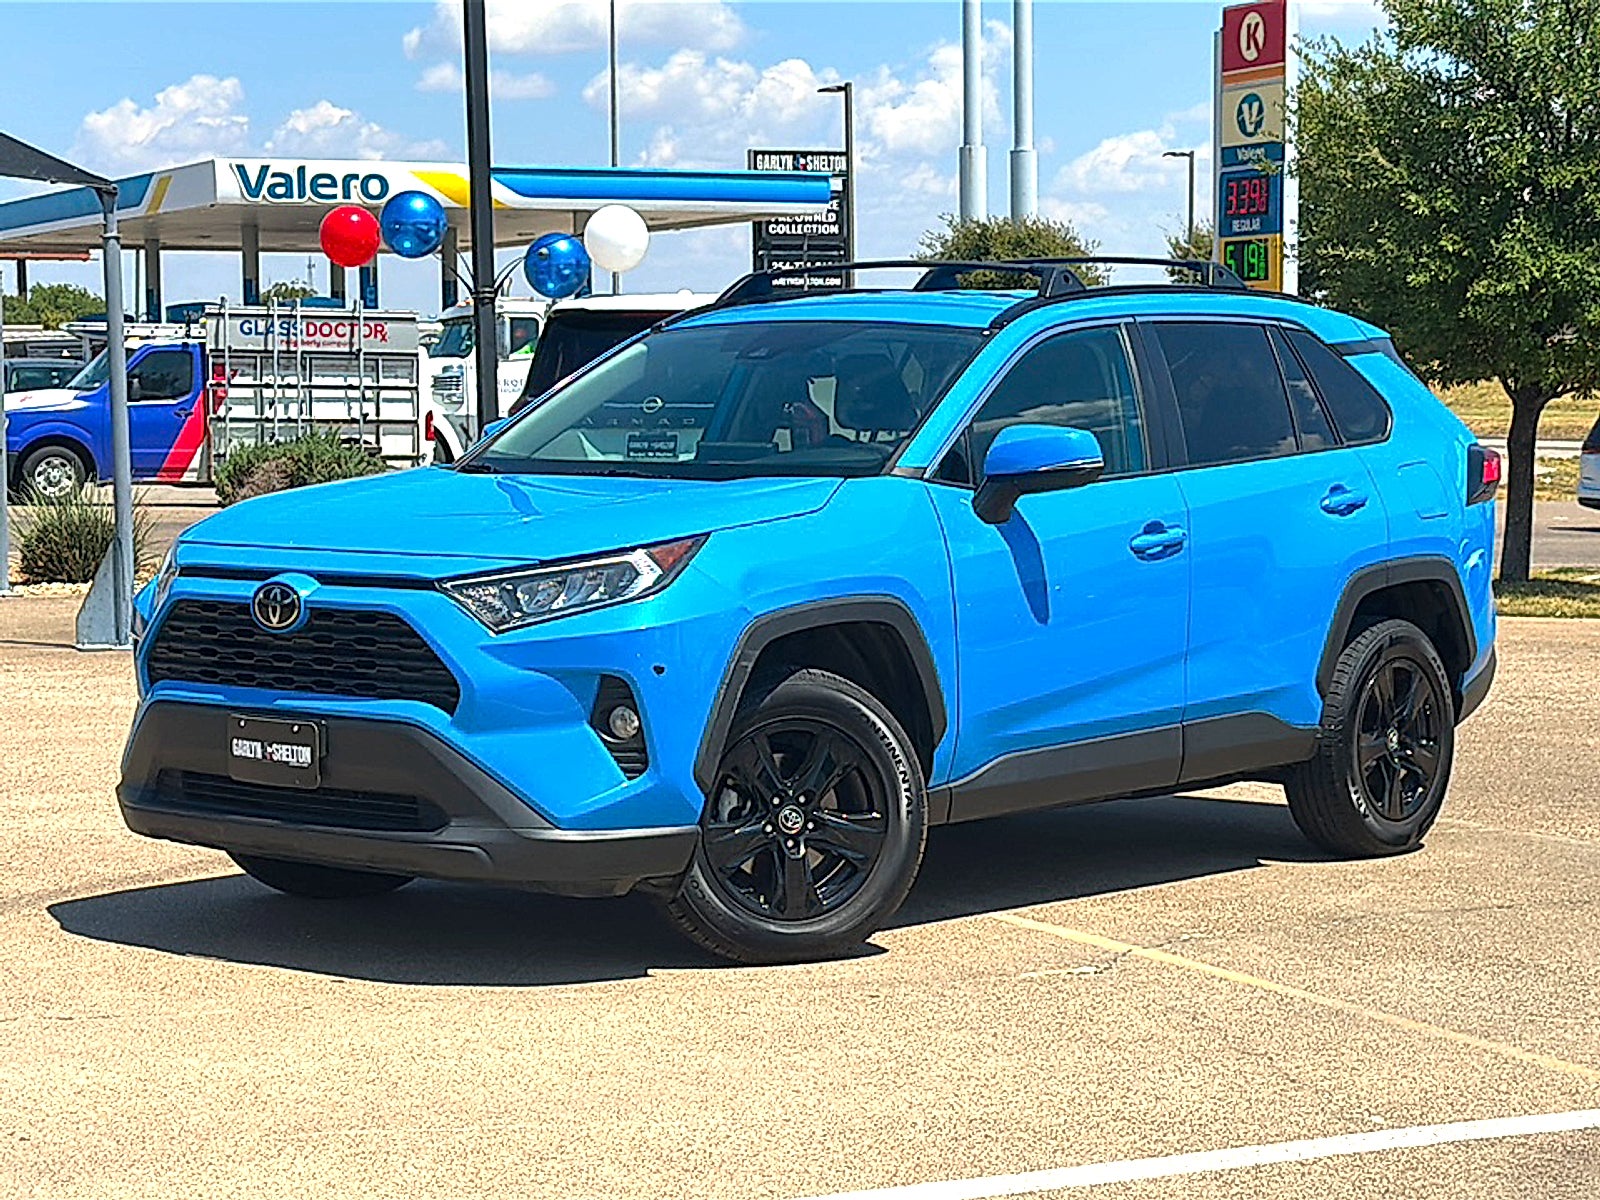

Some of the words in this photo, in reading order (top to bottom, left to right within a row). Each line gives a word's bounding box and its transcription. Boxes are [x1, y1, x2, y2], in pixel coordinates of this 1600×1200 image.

[756, 153, 794, 170] GARLYN
[806, 155, 847, 171] SHELTON
[235, 163, 390, 201] Valero
[768, 223, 840, 235] COLLECTION
[1231, 217, 1261, 232] REGULAR
[239, 319, 303, 336] GLASS
[232, 737, 262, 760] GARLYN
[271, 743, 312, 764] SHELTON
